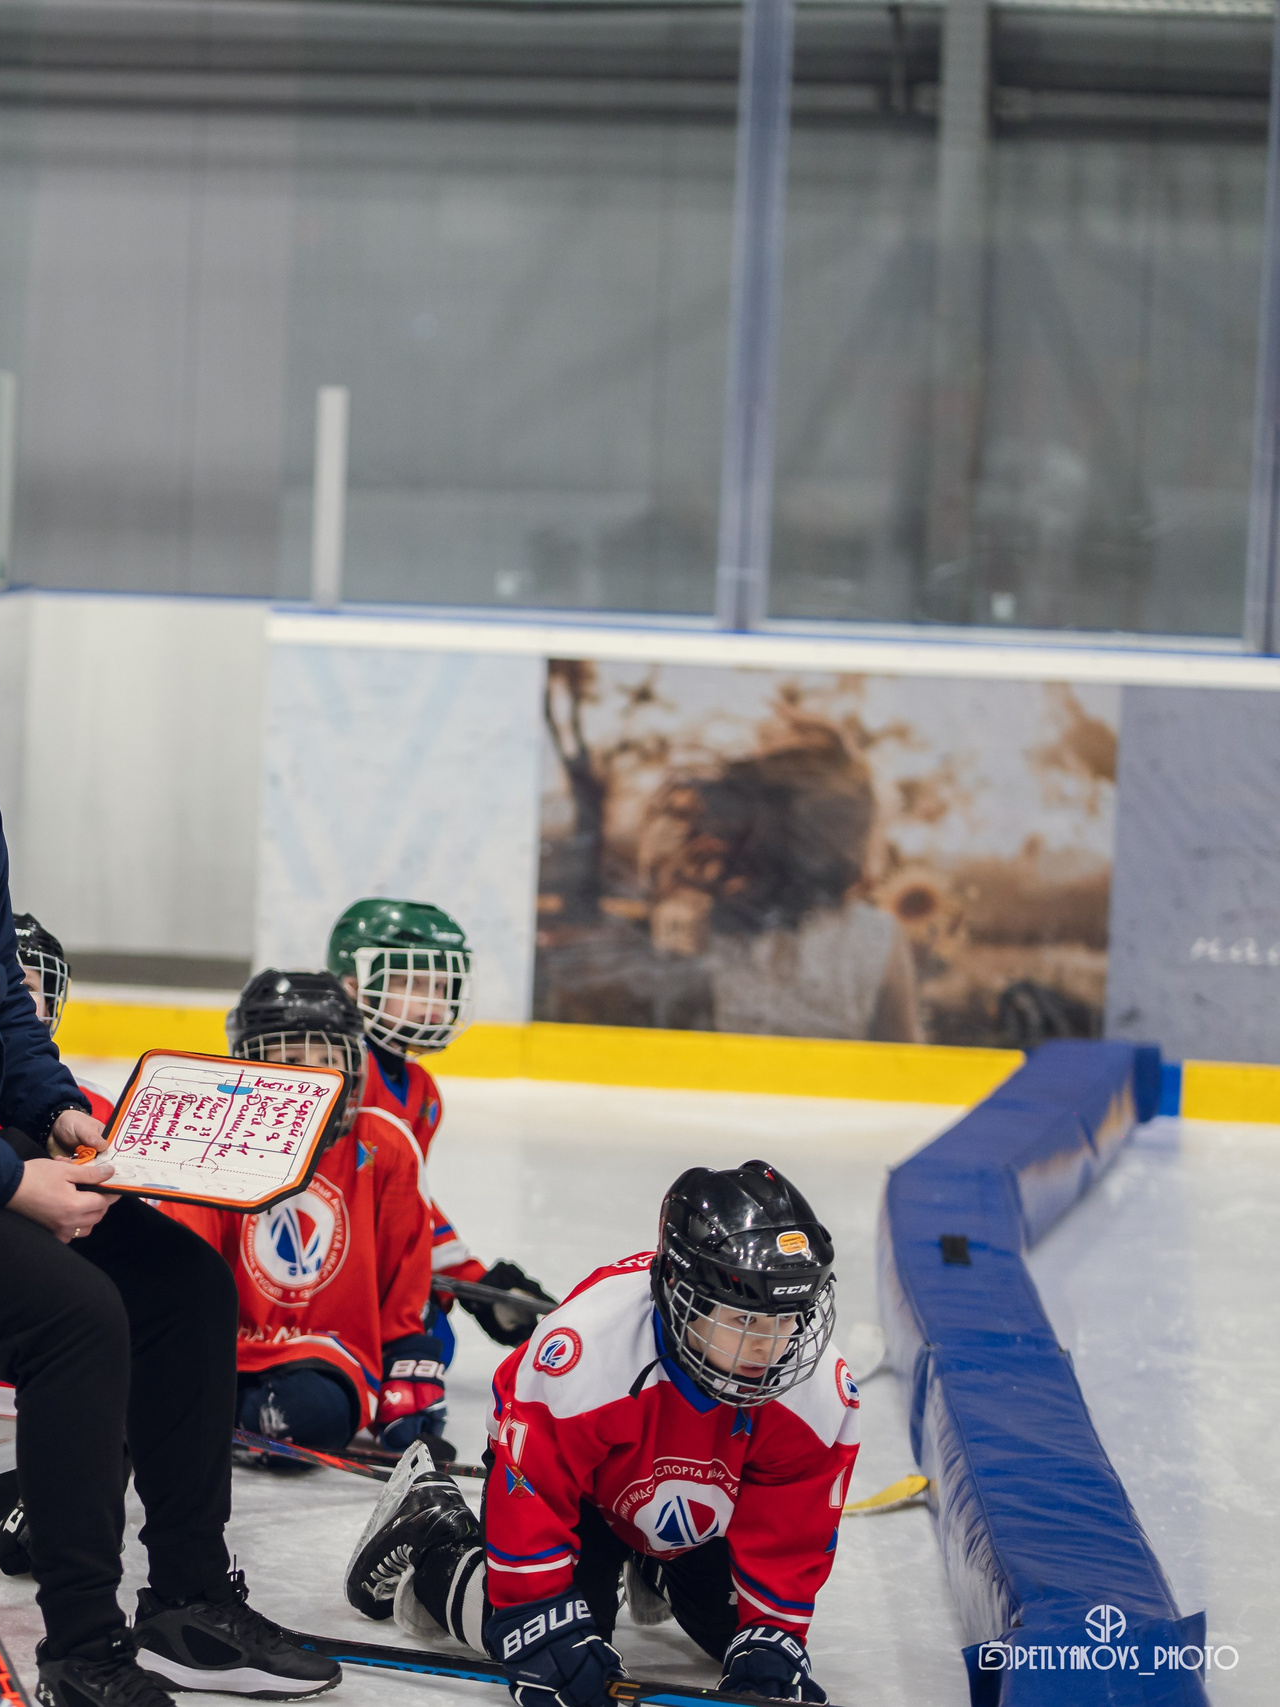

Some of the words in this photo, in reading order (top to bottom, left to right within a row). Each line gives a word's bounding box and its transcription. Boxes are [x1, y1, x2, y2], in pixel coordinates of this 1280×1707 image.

[669, 1247, 691, 1269] CCM
[772, 1283, 813, 1295] CCM
[654, 1465, 703, 1478] СПОРТА
[503, 1600, 592, 1660] BAUE
[723, 1627, 812, 1679] AUER
